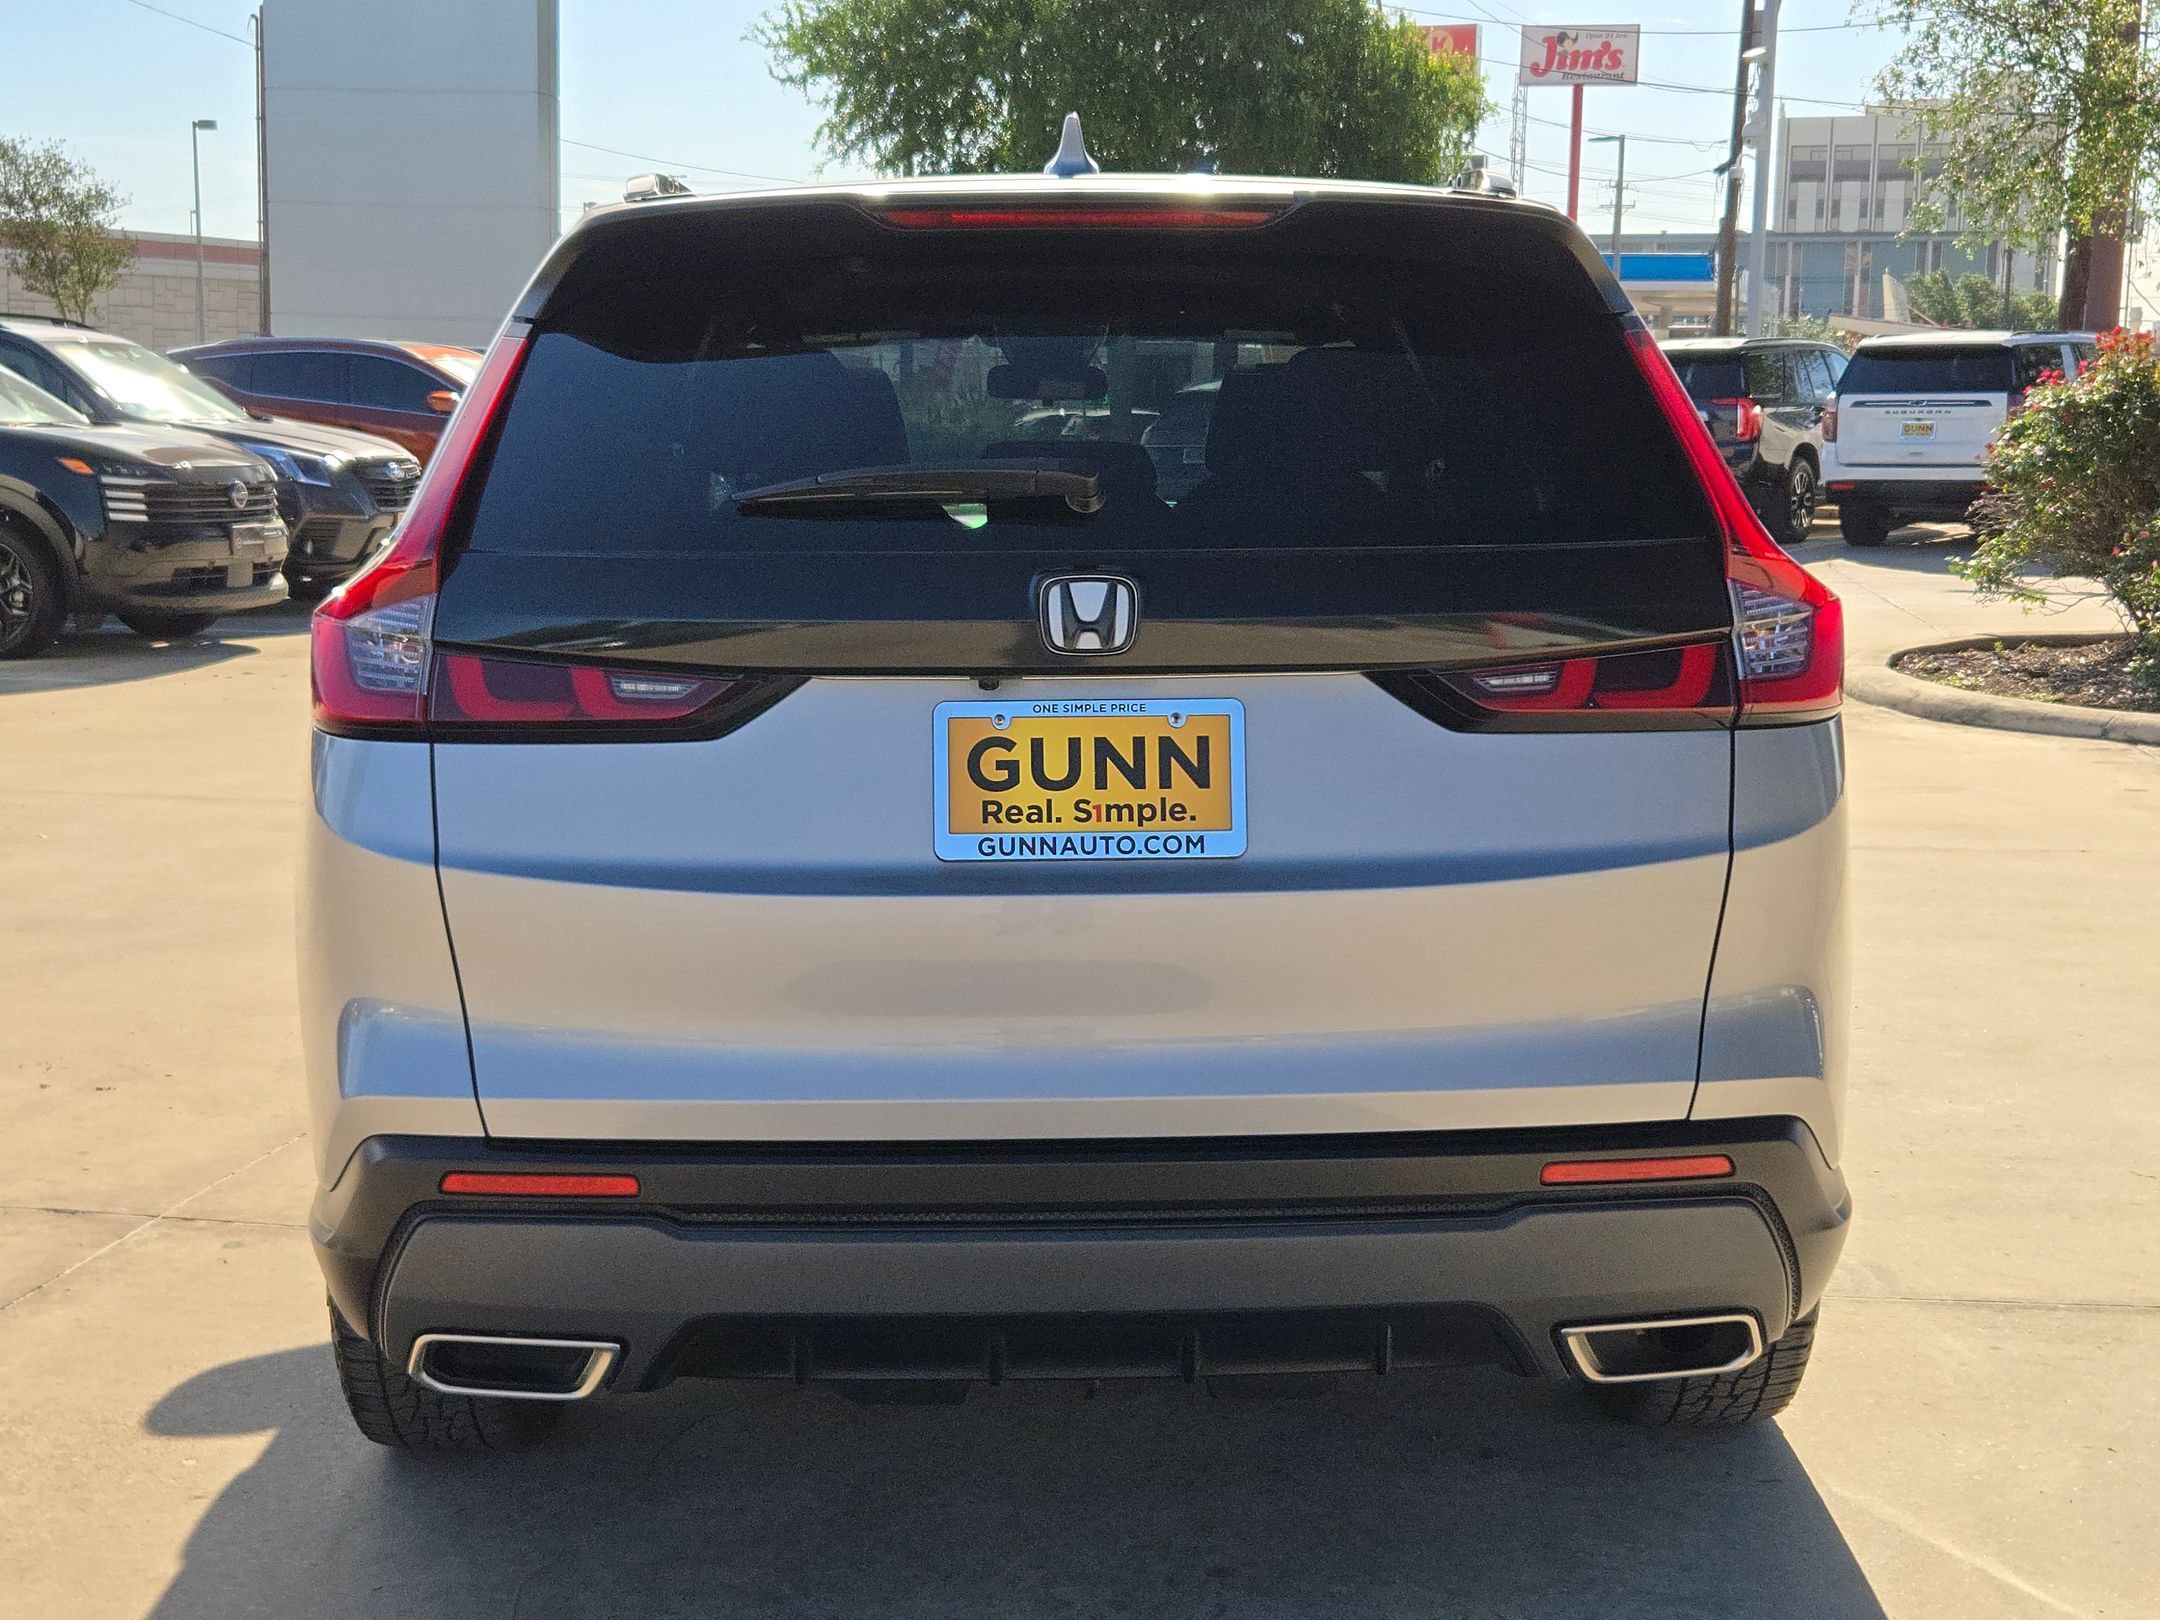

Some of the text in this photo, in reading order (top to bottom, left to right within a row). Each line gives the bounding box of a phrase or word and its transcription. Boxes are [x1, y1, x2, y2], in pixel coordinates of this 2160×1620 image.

[1530, 36, 1623, 77] Jim's
[1561, 71, 1624, 80] Restaurant
[1903, 424, 1933, 433] GUNN
[1032, 703, 1147, 714] ONE SIMPLE PRICE
[966, 735, 1211, 792] GUNN
[981, 798, 1062, 824] Real.
[977, 835, 1205, 857] GUNNAUTO.COM
